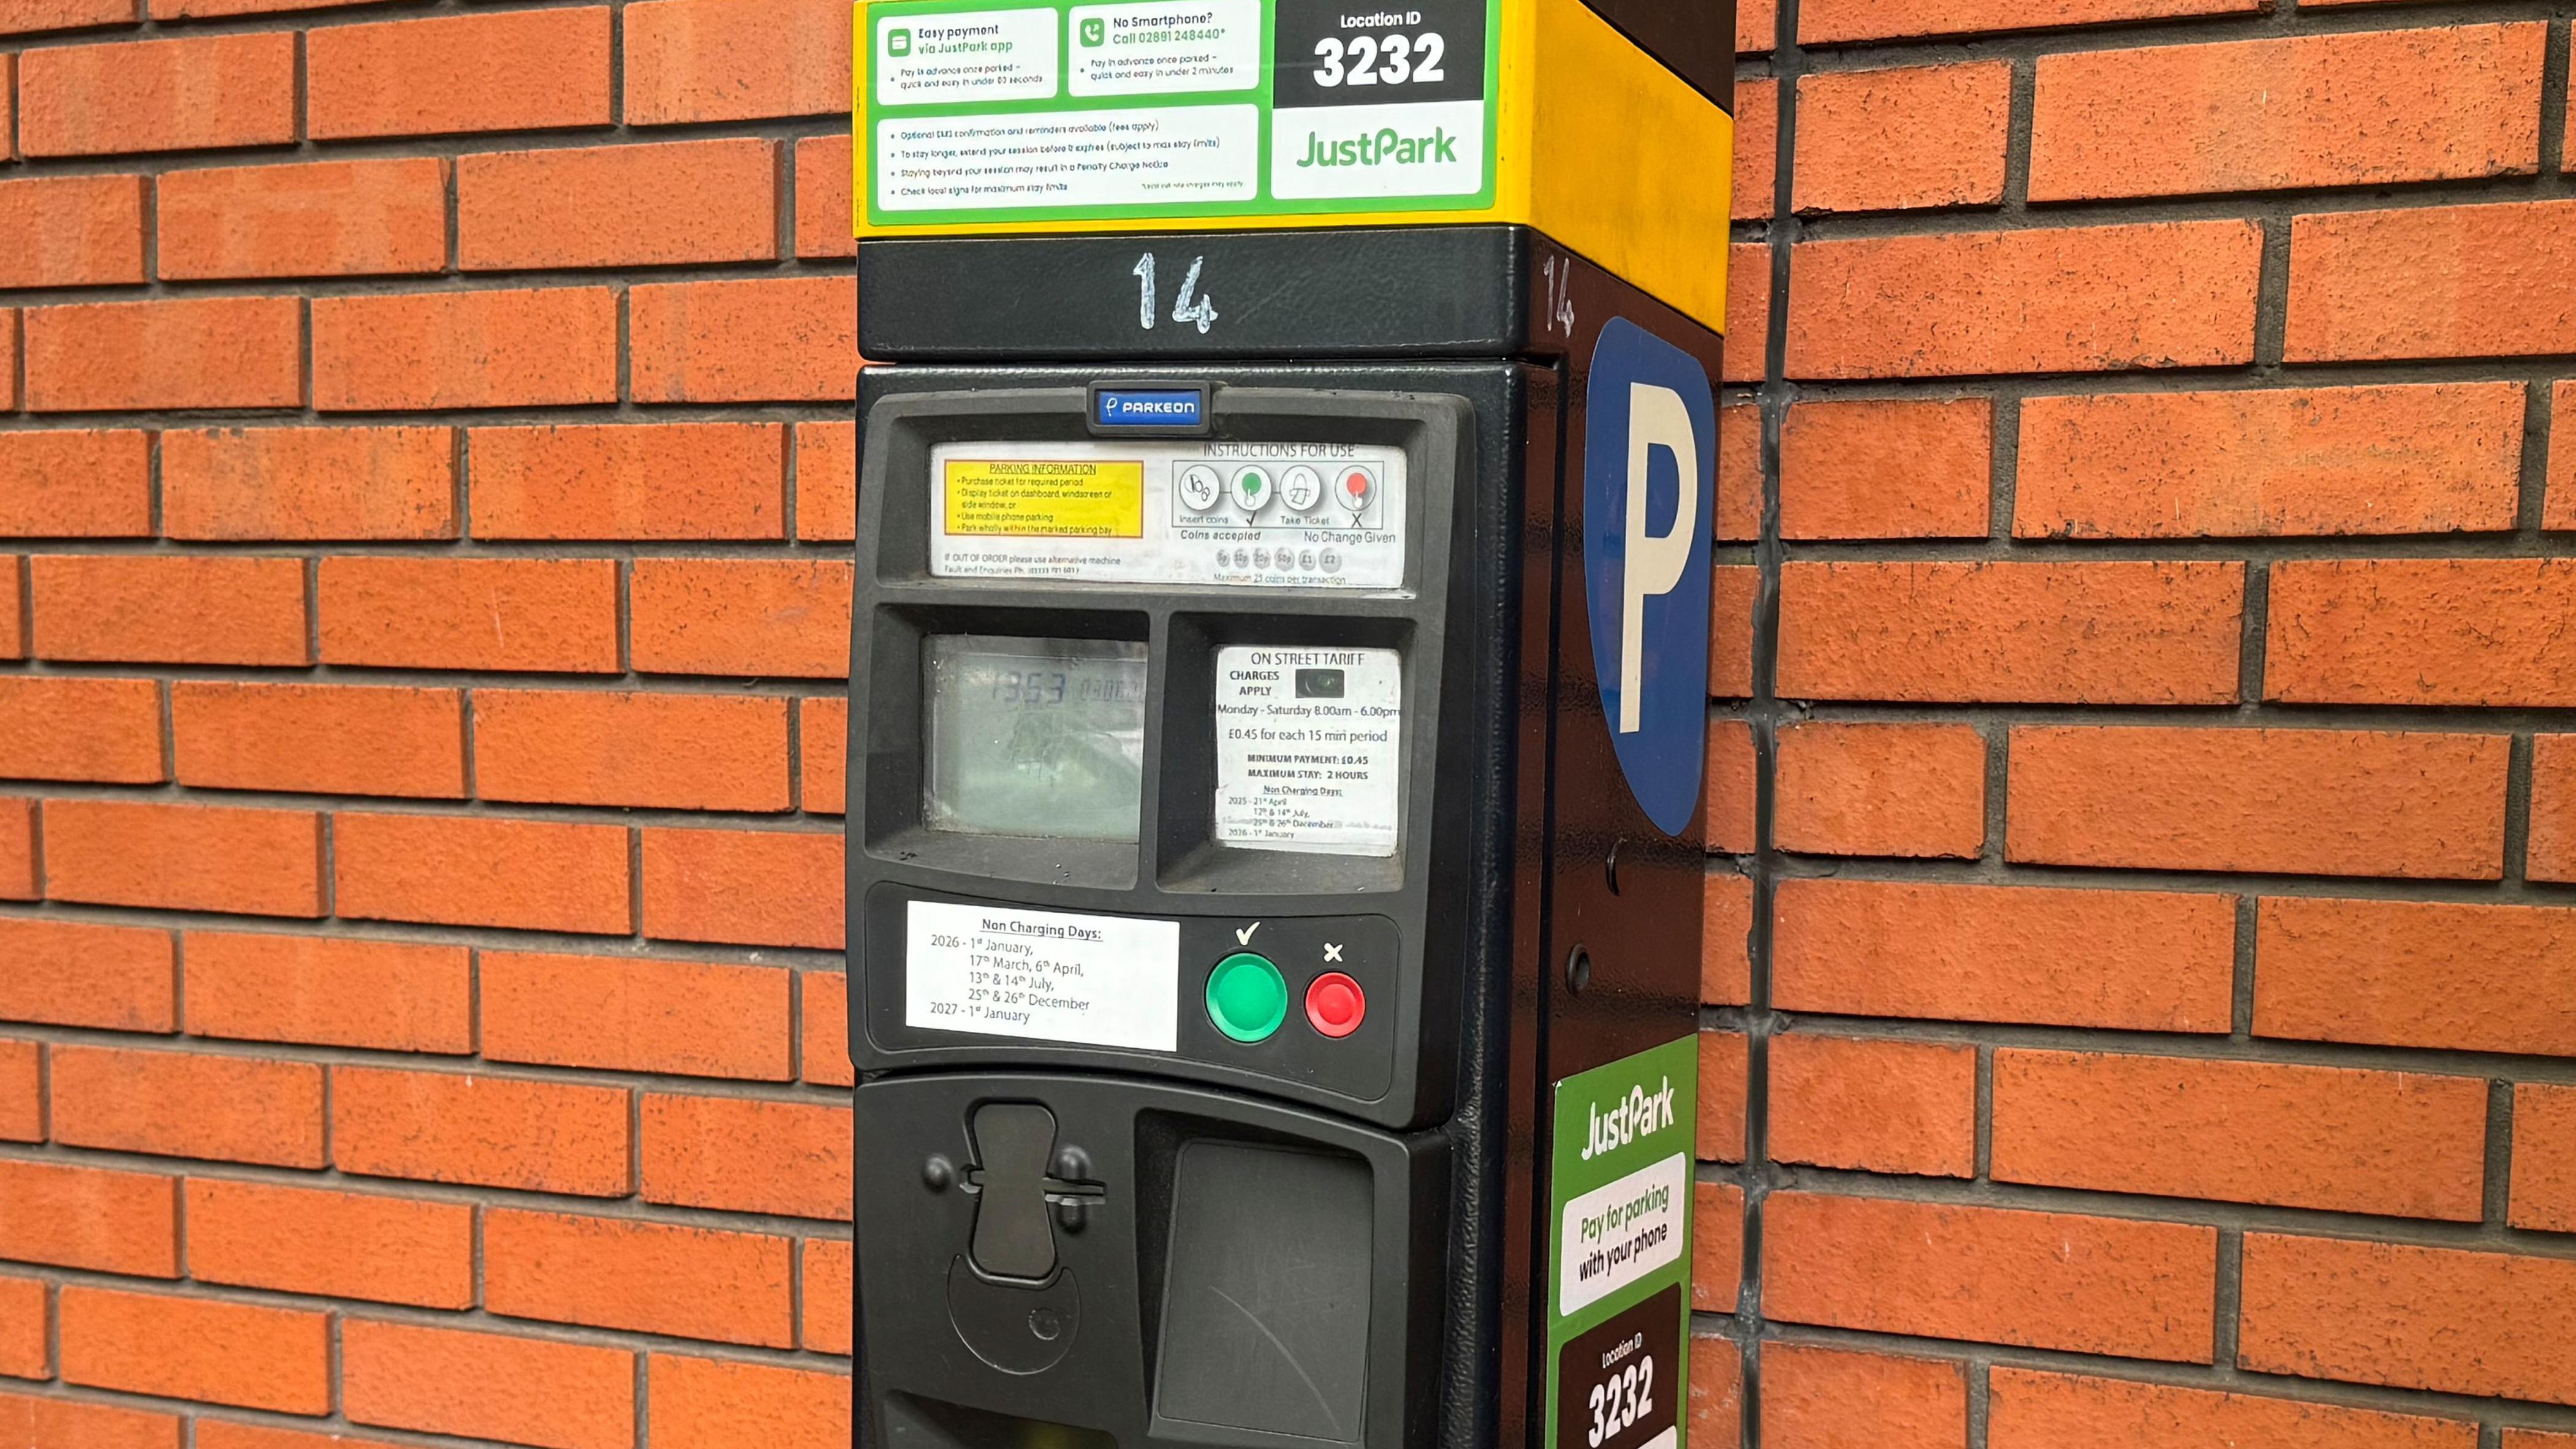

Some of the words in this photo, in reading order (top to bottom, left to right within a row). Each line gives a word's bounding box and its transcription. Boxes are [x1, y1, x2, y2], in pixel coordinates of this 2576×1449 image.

[1113, 17, 1128, 28] No
[1132, 12, 1213, 28] Smartphone?
[1341, 12, 1403, 28] Location
[1406, 11, 1421, 25] ID
[919, 28, 944, 40] Easy
[947, 25, 999, 39] payment
[1113, 33, 1135, 44] Call
[919, 42, 935, 54] via
[939, 42, 988, 53] JustPark
[990, 41, 1012, 53] app
[1314, 32, 1444, 87] 3232
[1297, 126, 1457, 167] JustPark
[1132, 252, 1219, 334] 14
[1544, 254, 1575, 338] 14
[1122, 400, 1195, 415] PARKEON
[1204, 444, 1297, 457] INSTRUCTIONS
[1301, 444, 1326, 458] FOR
[1330, 445, 1354, 458] USE
[990, 464, 1029, 474] PARKING
[1031, 464, 1096, 475] INFORMATION
[961, 477, 993, 486] Purchase
[995, 477, 1013, 486] ticket
[1016, 477, 1026, 486] for
[1028, 479, 1058, 488] required
[1059, 479, 1083, 488] period
[961, 490, 987, 499] Display
[1026, 513, 1053, 522] parking
[1281, 516, 1300, 524] Take
[1305, 516, 1329, 525] Ticket
[1181, 531, 1209, 540] Coins
[1213, 531, 1261, 541] accepted
[1305, 531, 1319, 542] No
[1321, 531, 1362, 545] Change
[1365, 531, 1396, 543] Given
[1619, 381, 1698, 734] P
[1251, 653, 1271, 665] ON
[1275, 653, 1319, 665] STREET
[1323, 653, 1365, 665] TARIFF
[1230, 671, 1279, 680] CHARGES
[1239, 686, 1271, 696] APPLY
[1218, 705, 1258, 715] Monday
[1267, 705, 1311, 718] Saturday
[1314, 706, 1351, 716] 8.00am
[1229, 729, 1257, 740] £0.45
[1260, 728, 1276, 740] for
[1279, 729, 1305, 741] each
[1309, 730, 1320, 741] 15
[1325, 730, 1346, 741] min
[1350, 730, 1387, 744] period
[1248, 754, 1292, 763] MINIMUM
[1294, 755, 1339, 764] PAYMENT:
[1341, 756, 1368, 765] £0.45
[1248, 770, 1295, 778] MAXIMUM
[1297, 770, 1322, 779] STAY:
[1282, 786, 1317, 795] Charging
[982, 919, 1006, 931] Non
[1010, 921, 1064, 937] Charging
[1068, 926, 1101, 940] Days:
[931, 935, 960, 948] 2026
[985, 940, 1033, 956] January,
[993, 957, 1032, 973] March,
[1053, 963, 1084, 977] April,
[993, 974, 1001, 985] &
[1028, 977, 1054, 993] July,
[993, 991, 1001, 1002] &
[1029, 994, 1089, 1011] December
[930, 1003, 957, 1015] 2027
[984, 1007, 1029, 1025] January
[1581, 1075, 1675, 1160] JustPark
[1581, 1214, 1603, 1244] Pay
[1607, 1204, 1623, 1228] for
[1626, 1182, 1669, 1231] parking
[1580, 1249, 1604, 1282] with
[1607, 1238, 1631, 1273] your
[1634, 1223, 1667, 1263] phone
[1602, 1337, 1633, 1368] Location
[1588, 1354, 1653, 1448] 3232
